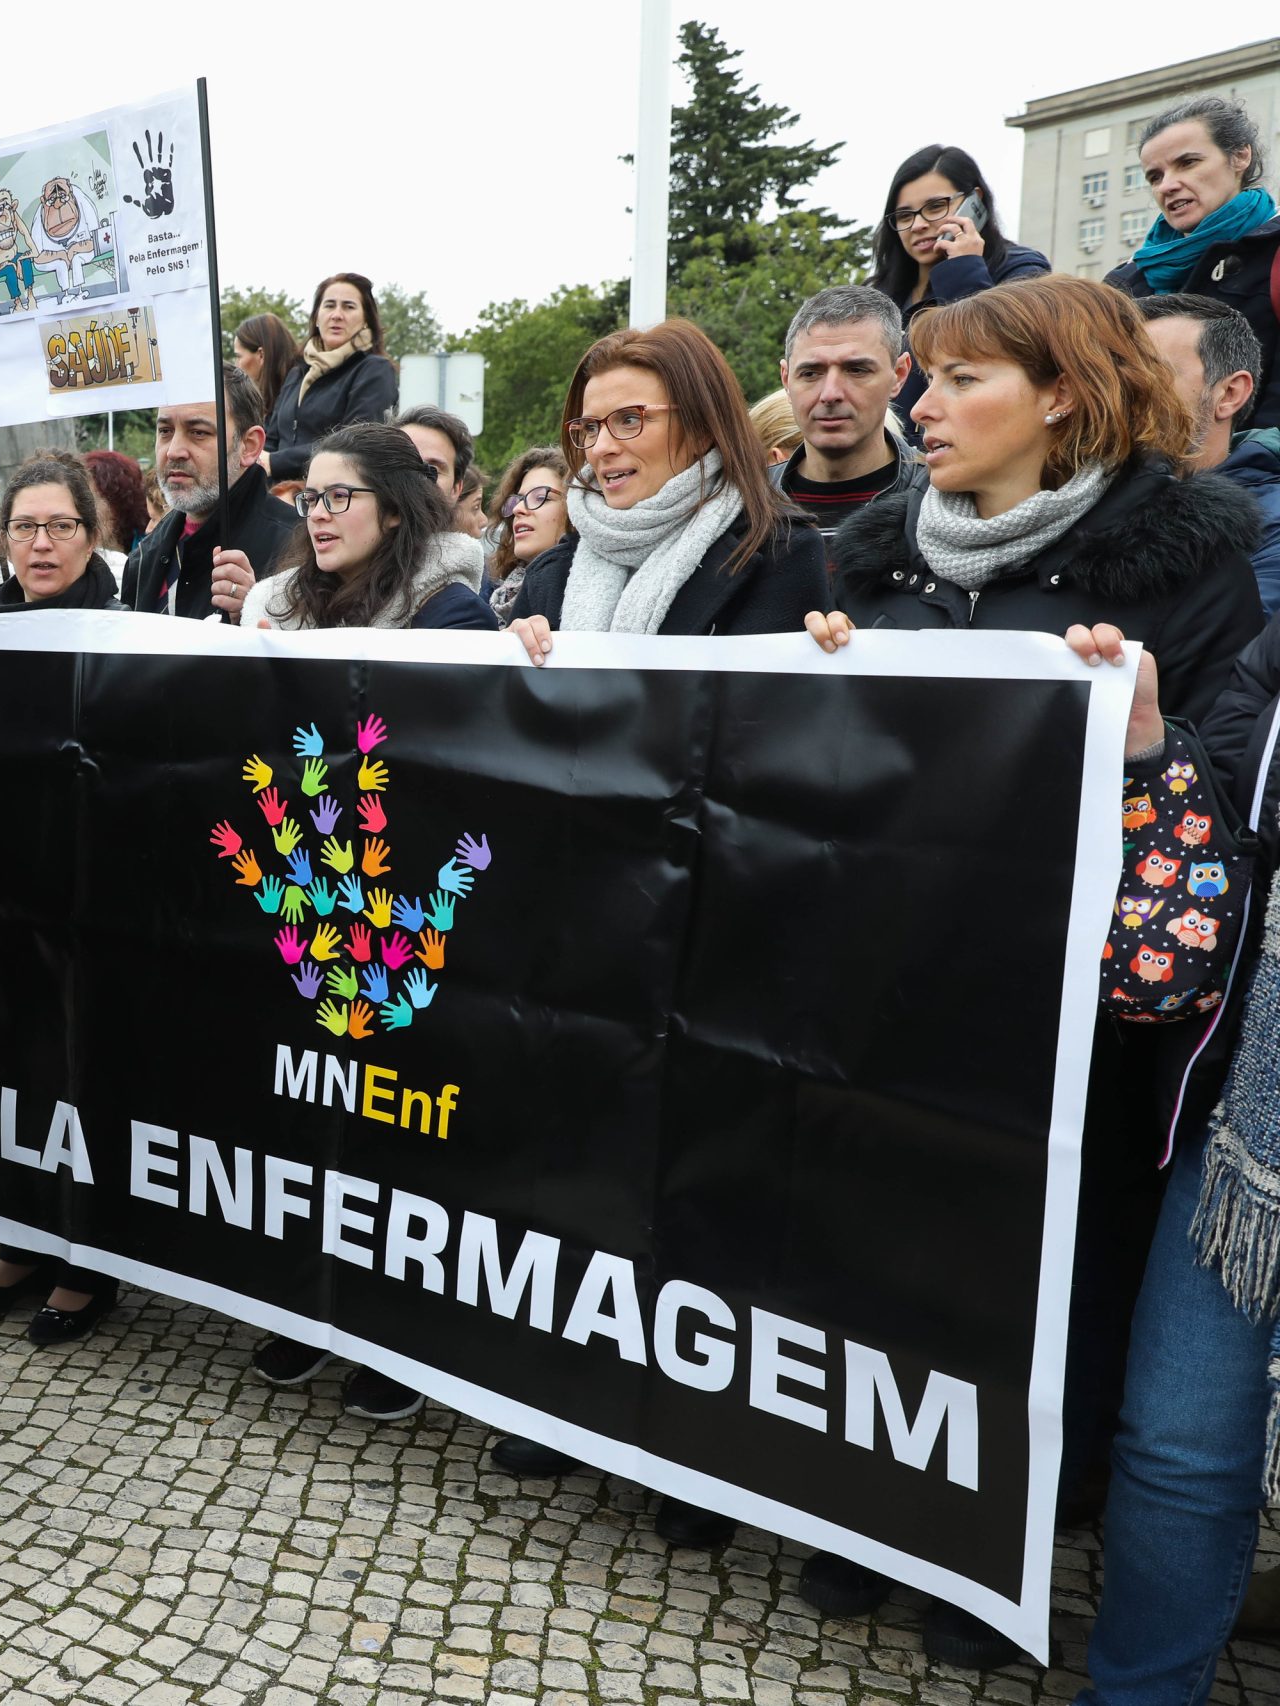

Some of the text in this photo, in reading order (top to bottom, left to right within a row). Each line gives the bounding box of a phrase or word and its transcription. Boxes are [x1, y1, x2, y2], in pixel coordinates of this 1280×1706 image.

[129, 253, 146, 263] Pela
[147, 242, 199, 260] Enfermagem
[148, 231, 180, 243] Basta...
[146, 265, 166, 276] Pelo
[167, 260, 184, 272] SNS
[47, 320, 134, 388] SAÚDE
[273, 1043, 461, 1140] MNEnf
[130, 1119, 979, 1492] ENFERMAGEM
